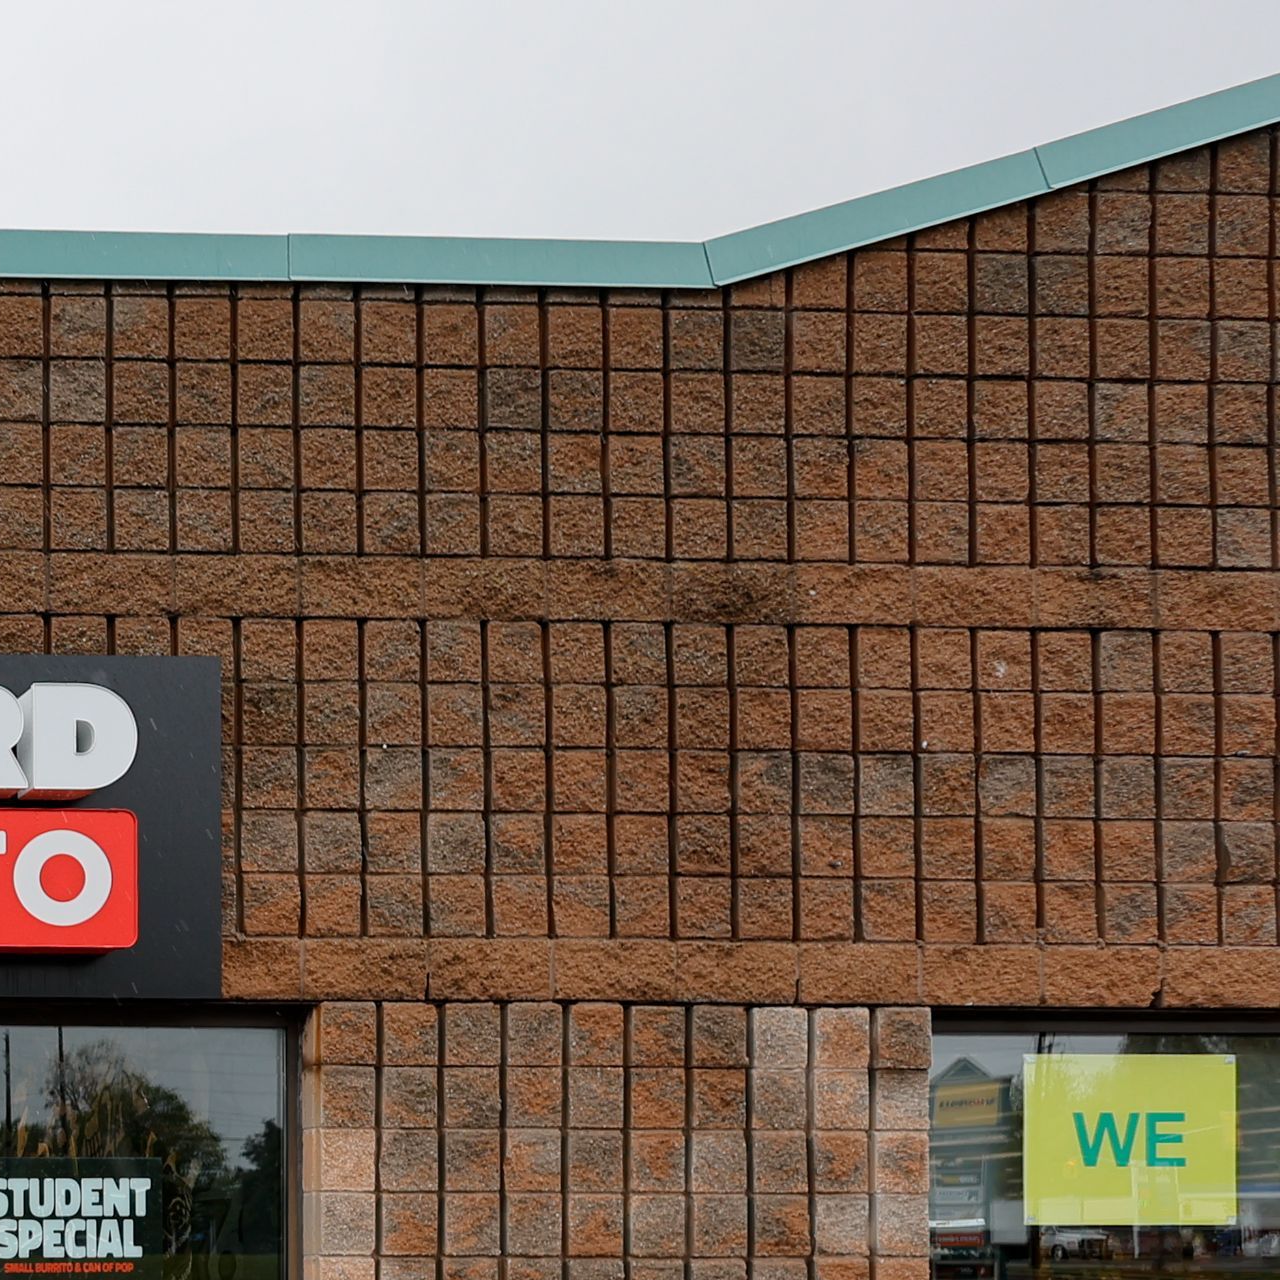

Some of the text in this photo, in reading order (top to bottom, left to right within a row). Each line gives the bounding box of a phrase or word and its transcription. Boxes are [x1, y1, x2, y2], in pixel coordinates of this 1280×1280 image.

[1072, 1111, 1187, 1167] WE
[4, 1263, 33, 1273] SMALL
[35, 1263, 73, 1273] BURRITO
[83, 1263, 100, 1273] CAN
[102, 1263, 114, 1272] OF
[115, 1262, 134, 1273] POP
